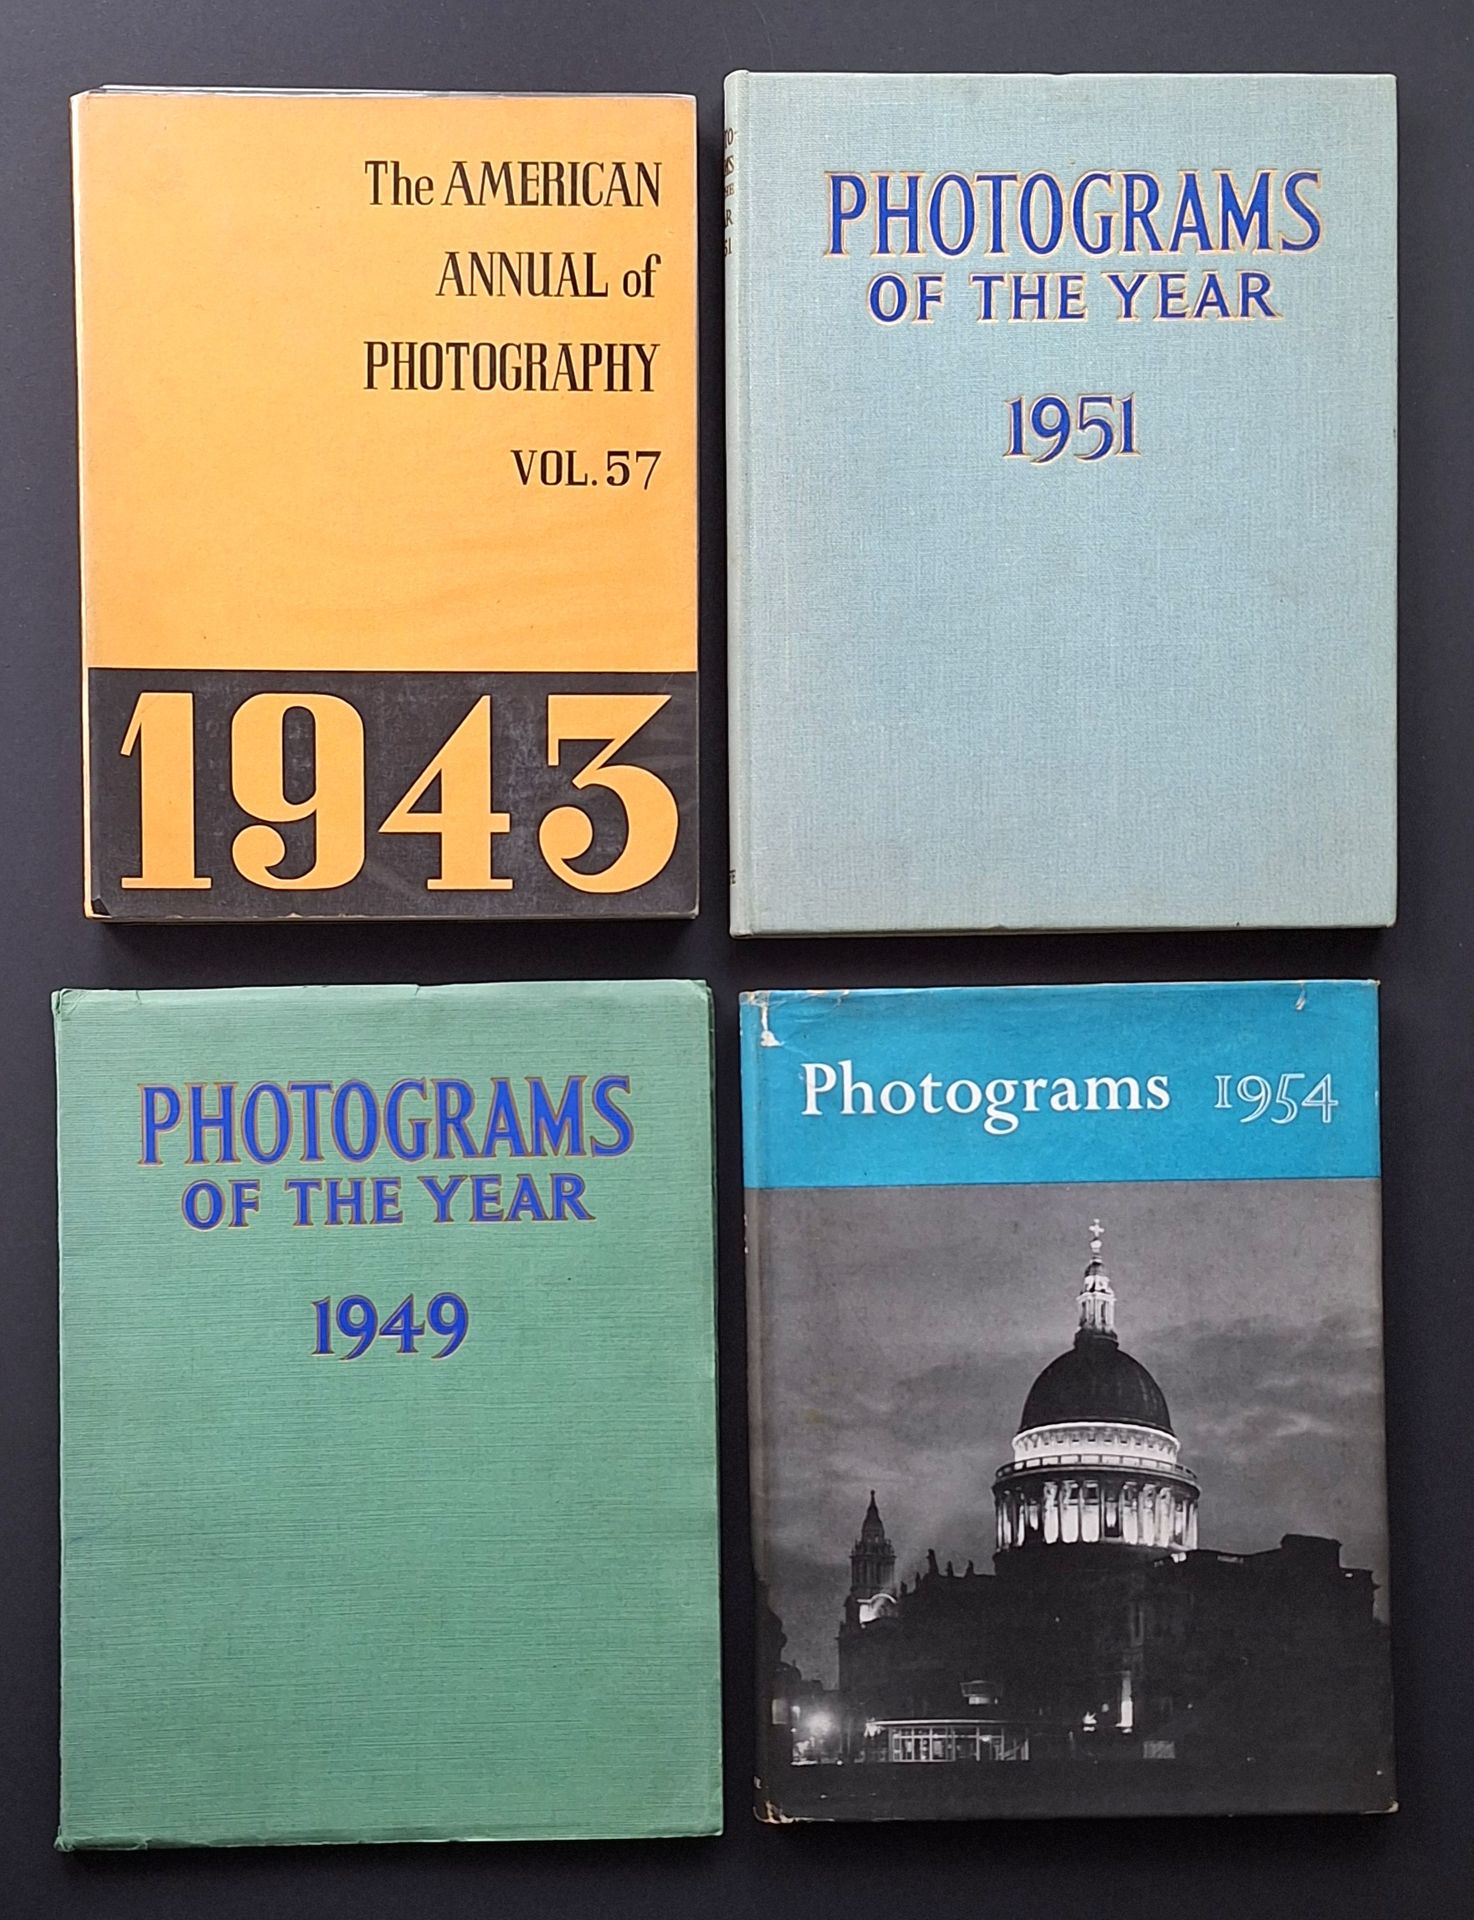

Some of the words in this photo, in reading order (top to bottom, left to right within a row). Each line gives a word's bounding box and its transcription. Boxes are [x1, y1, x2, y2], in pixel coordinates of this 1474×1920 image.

[364, 160, 434, 206] The
[441, 160, 662, 207] AMERICAN
[825, 168, 1322, 258] PHOTOGRAMS
[435, 251, 609, 298] ANNUAL
[622, 253, 662, 298] of
[867, 271, 945, 326] OF
[971, 272, 1088, 324] THE
[1101, 270, 1281, 322] YEAR
[363, 341, 661, 392] PHOTOGRAPHY
[1003, 391, 1140, 466] 1951
[119, 690, 680, 893] 1943
[138, 1073, 634, 1166] PHOTOGRAMS
[801, 1059, 1171, 1136] Photograms
[1214, 1072, 1340, 1125] 1954
[182, 1179, 261, 1231] OF
[286, 1177, 403, 1227] THE
[418, 1173, 595, 1225] YEAR
[311, 1290, 470, 1360] 1949
